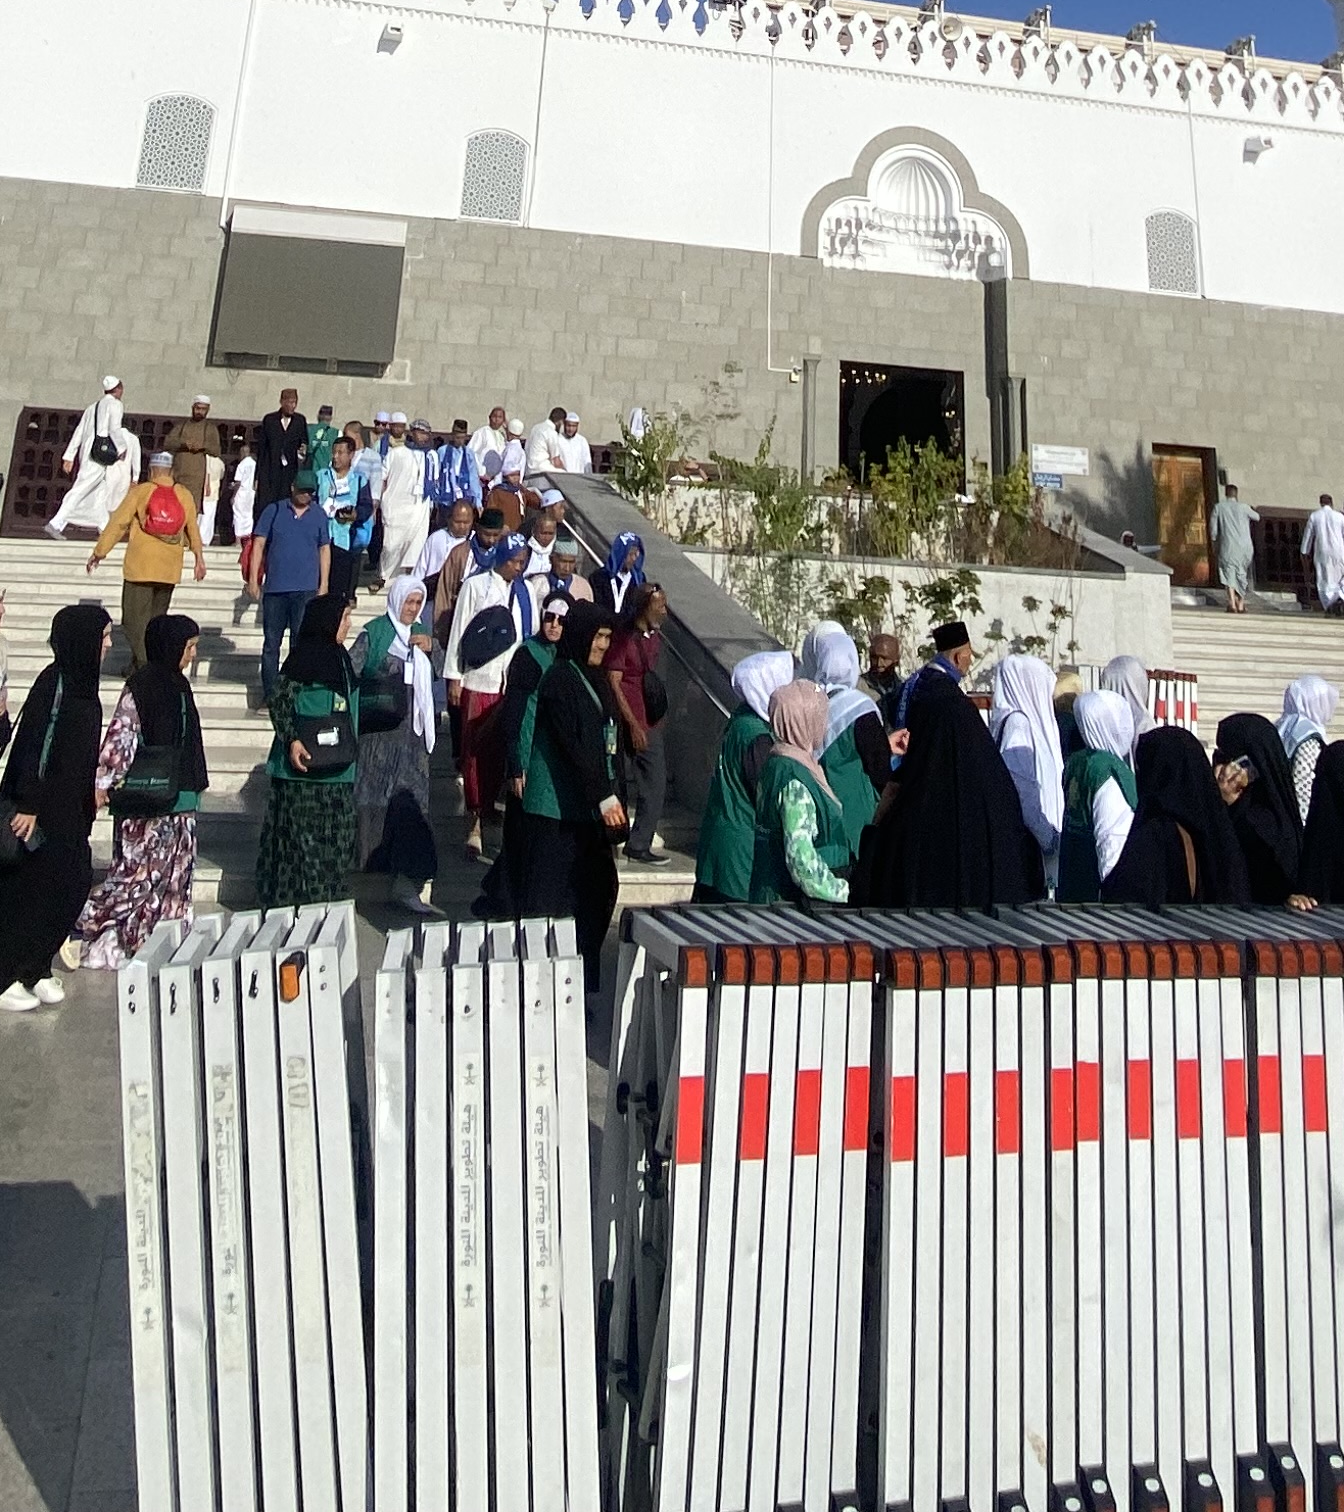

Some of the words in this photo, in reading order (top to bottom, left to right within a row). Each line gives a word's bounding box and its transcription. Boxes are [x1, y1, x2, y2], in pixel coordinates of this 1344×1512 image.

[461, 1104, 474, 1134] هيئة
[534, 1105, 547, 1135] هيئة
[461, 1140, 474, 1180] تطوير
[534, 1141, 548, 1181] تطوير
